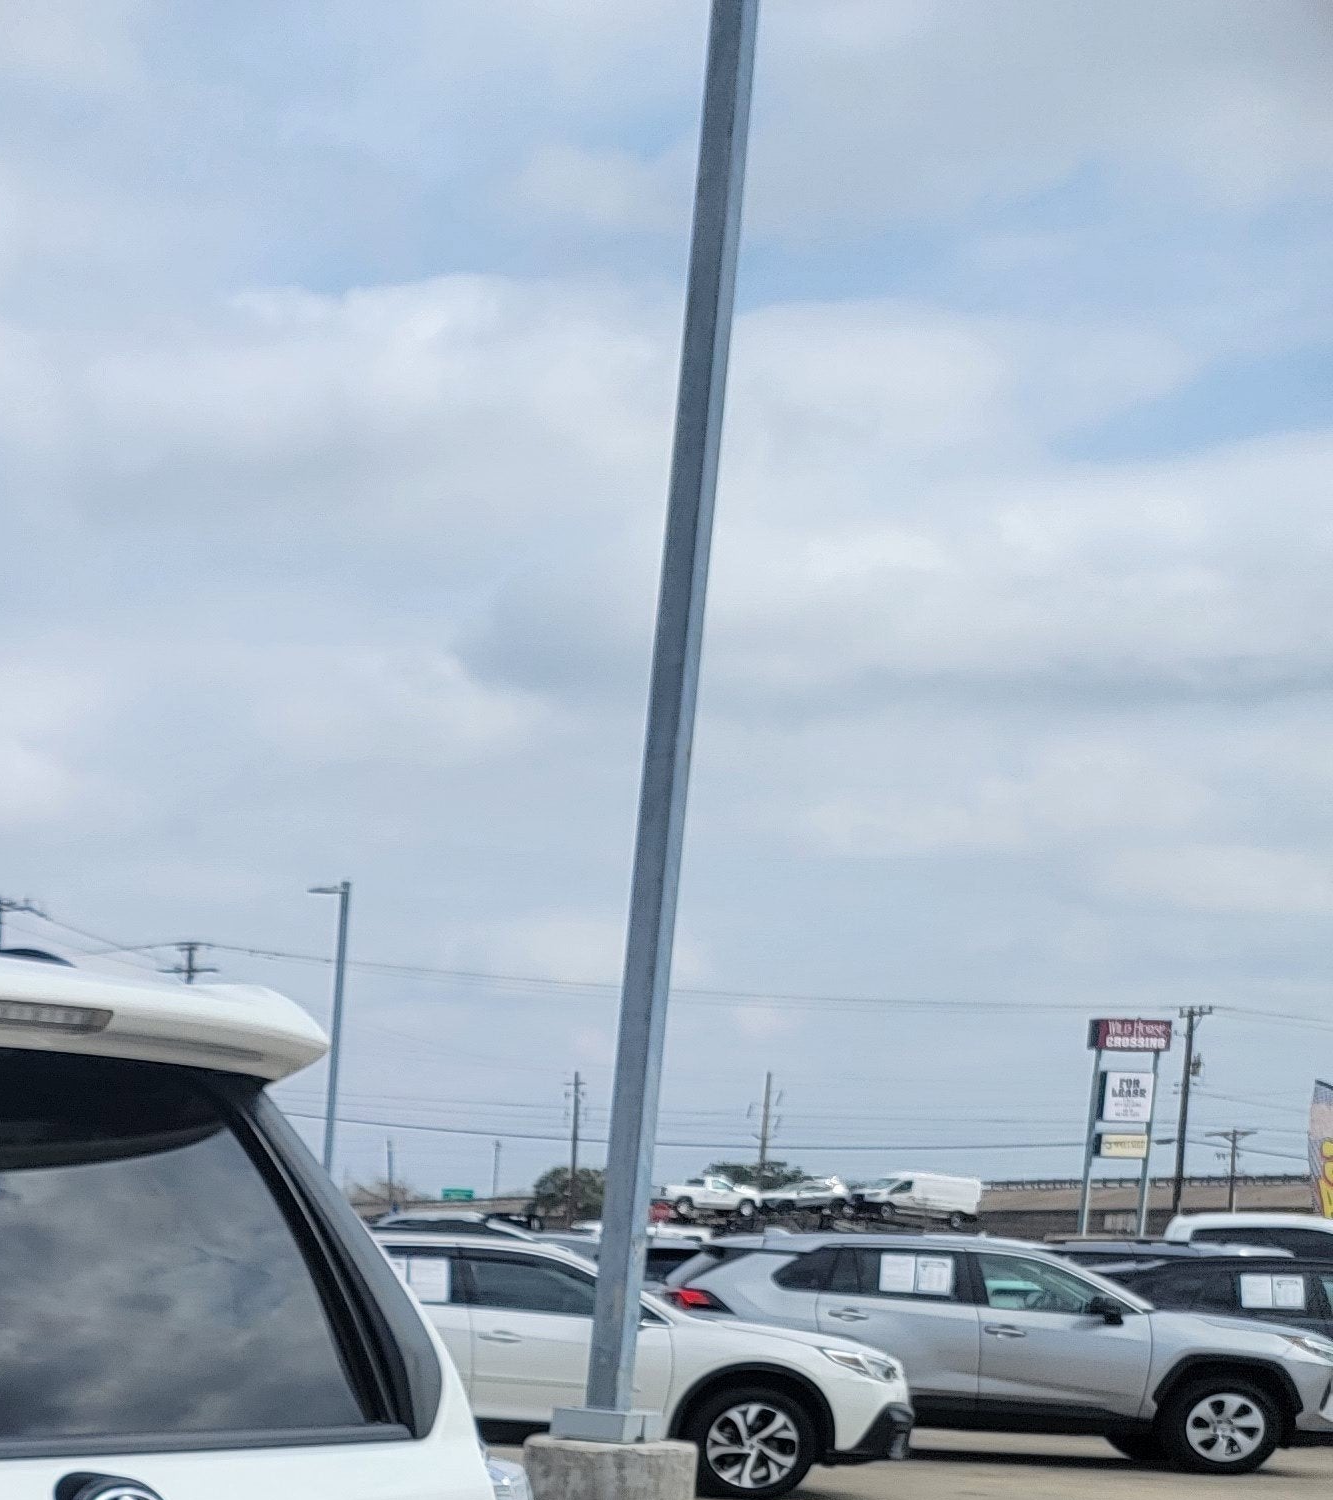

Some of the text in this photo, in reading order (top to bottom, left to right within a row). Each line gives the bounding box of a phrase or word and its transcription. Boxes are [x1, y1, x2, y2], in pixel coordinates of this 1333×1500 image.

[1106, 1035, 1166, 1049] CROSSING
[1119, 1078, 1140, 1089] FOR
[1112, 1087, 1146, 1098] LEASE
